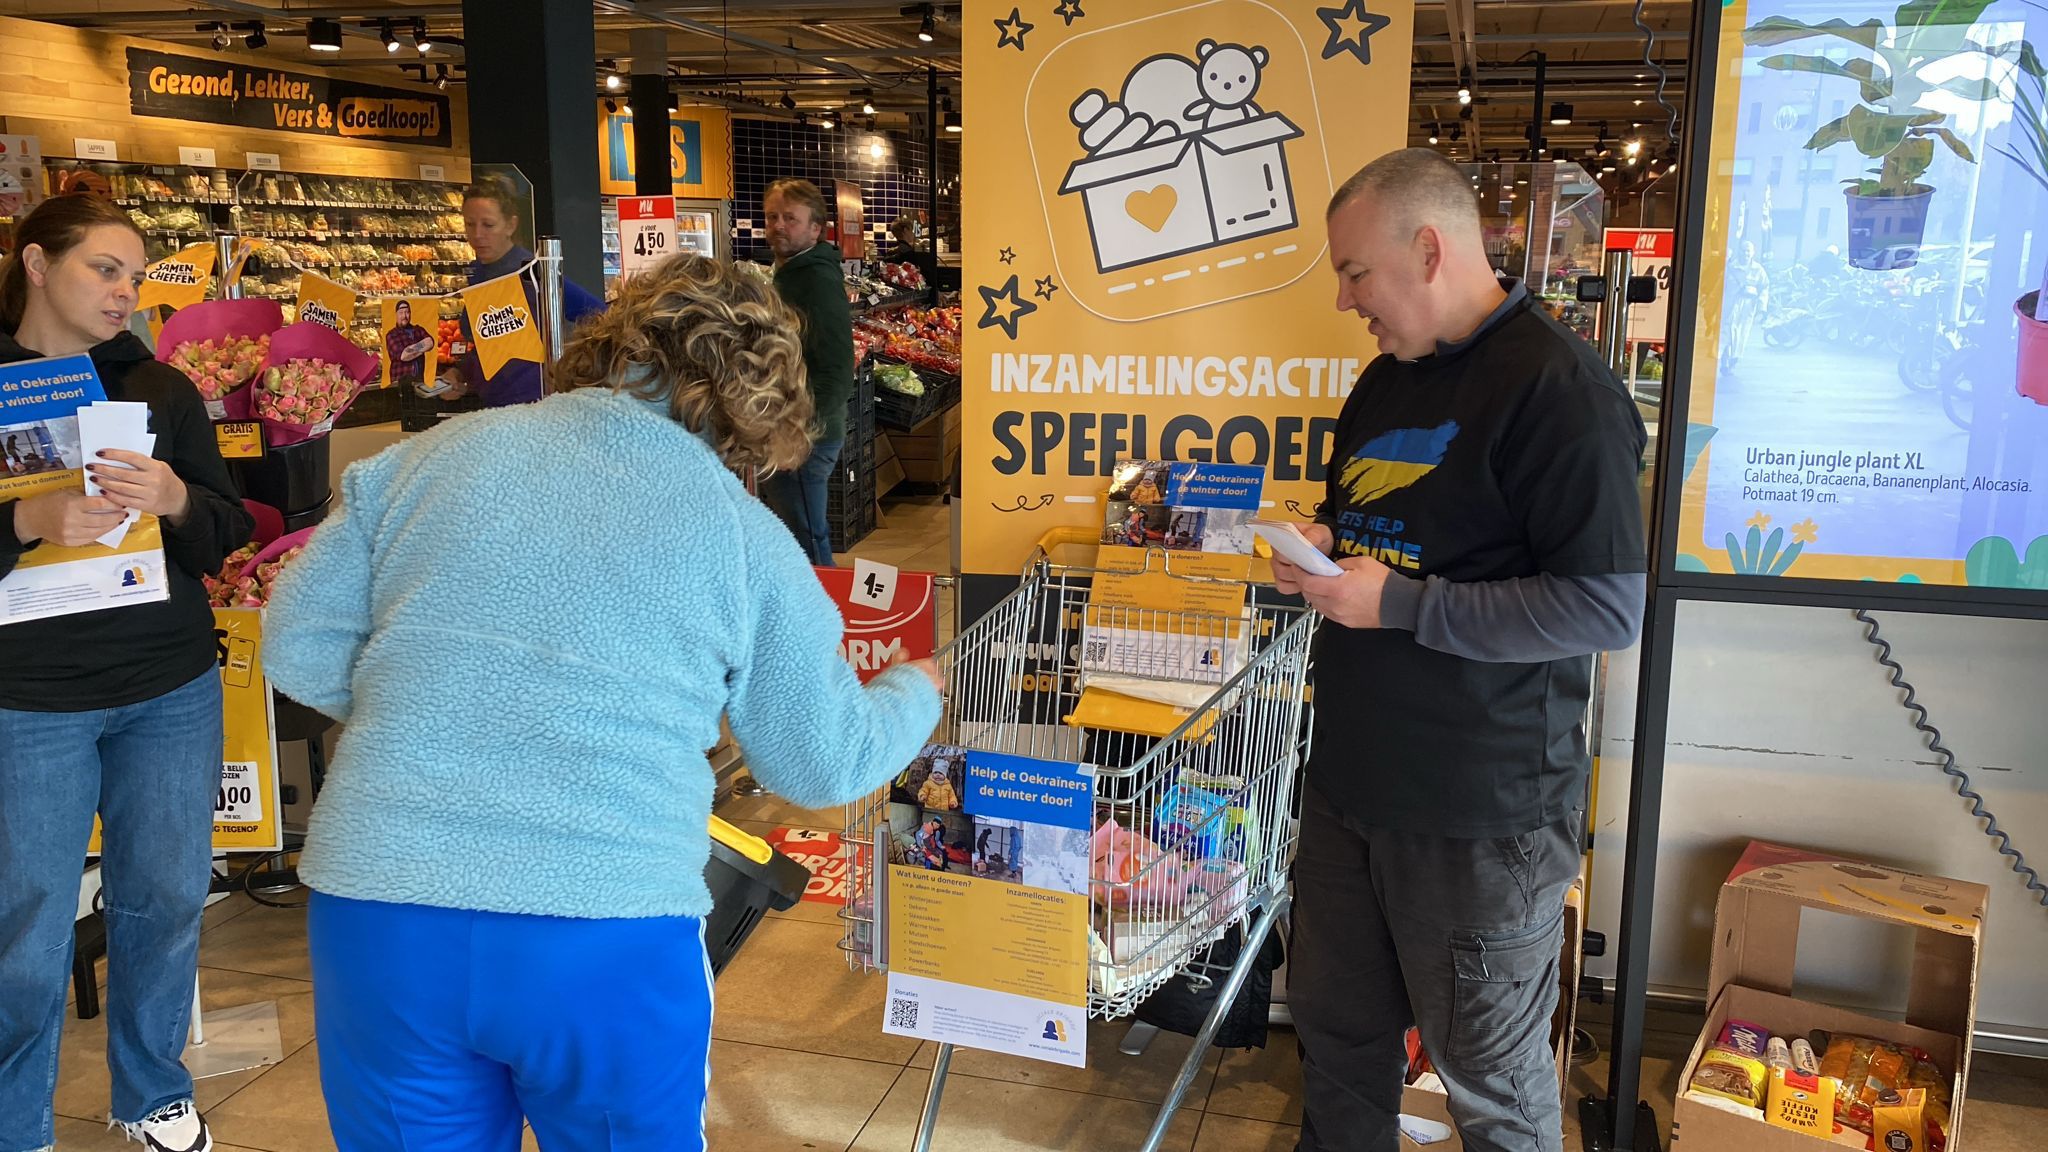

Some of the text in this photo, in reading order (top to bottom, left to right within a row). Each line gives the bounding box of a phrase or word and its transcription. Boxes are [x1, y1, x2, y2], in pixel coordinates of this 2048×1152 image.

[149, 66, 314, 105] Gezond, Lekker,
[273, 103, 434, 136] Vers & Goedkoop!
[148, 271, 196, 283] CHEFFEN
[156, 262, 194, 273] SAMEN
[306, 302, 337, 321] SAMEN
[482, 305, 514, 326] SAMEN
[480, 318, 524, 338] CHEFFEN
[991, 353, 1358, 398] INZAMELINGSACTIE
[2, 382, 19, 391] de
[6, 394, 47, 407] winter
[51, 388, 84, 400] door!
[223, 424, 253, 434] GRATIS
[1746, 447, 1924, 473] Urban jungle plant XL
[1744, 468, 2032, 493] Calathea, Dracaena, Bananenplant, Alocasia.
[1191, 486, 1221, 495] winter
[1223, 487, 1248, 496] door!
[1743, 486, 1839, 504] Potmaat 19 cm.
[1366, 515, 1405, 534] HELP
[1338, 528, 1421, 569] RAINE
[970, 765, 1087, 791] Help de Oekraïners
[979, 785, 1073, 807] de winter door!
[896, 869, 911, 878] Wat
[913, 872, 929, 881] kunt
[937, 876, 972, 888] doneren?
[895, 988, 918, 998] Donaties
[1781, 1100, 1818, 1114] KOFFIE
[1783, 1107, 1816, 1120] BESTE
